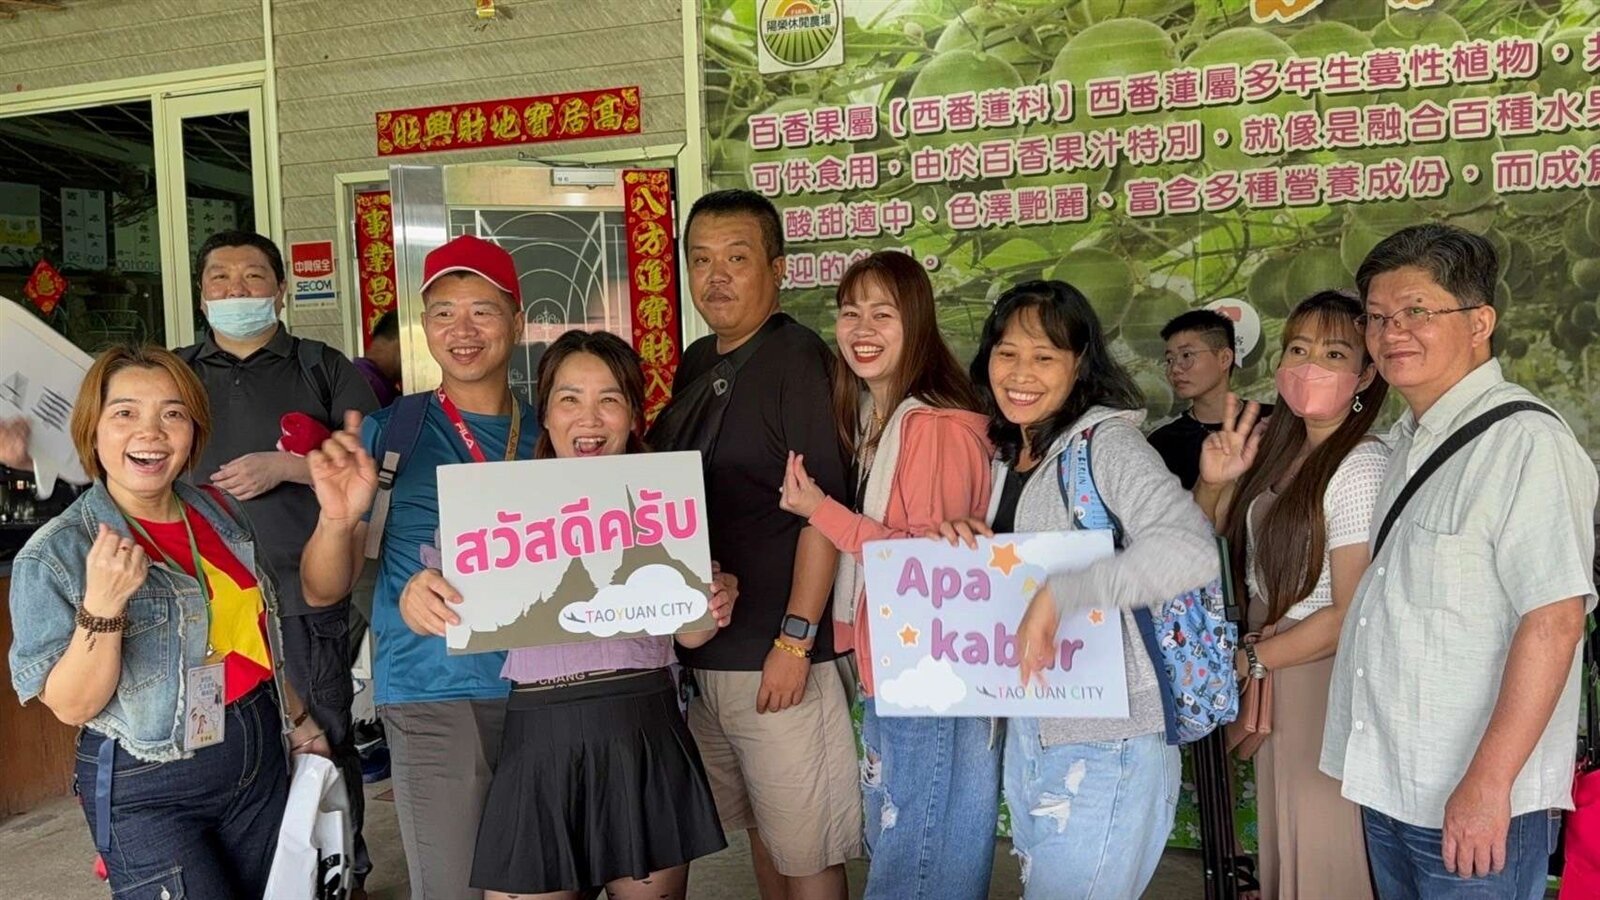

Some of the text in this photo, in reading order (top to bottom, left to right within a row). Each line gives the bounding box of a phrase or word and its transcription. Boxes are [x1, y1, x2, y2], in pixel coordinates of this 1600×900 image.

[296, 280, 332, 292] SECOM
[632, 186, 674, 422] 八方進寶財入
[455, 421, 475, 450] FILA
[455, 489, 698, 575] สวัสดีครับ
[896, 556, 992, 609] Apa
[585, 601, 693, 624] TAOYUAN CITY
[931, 618, 1085, 672] kabr
[539, 671, 586, 685] CHANG
[1070, 685, 1104, 700] CITY
